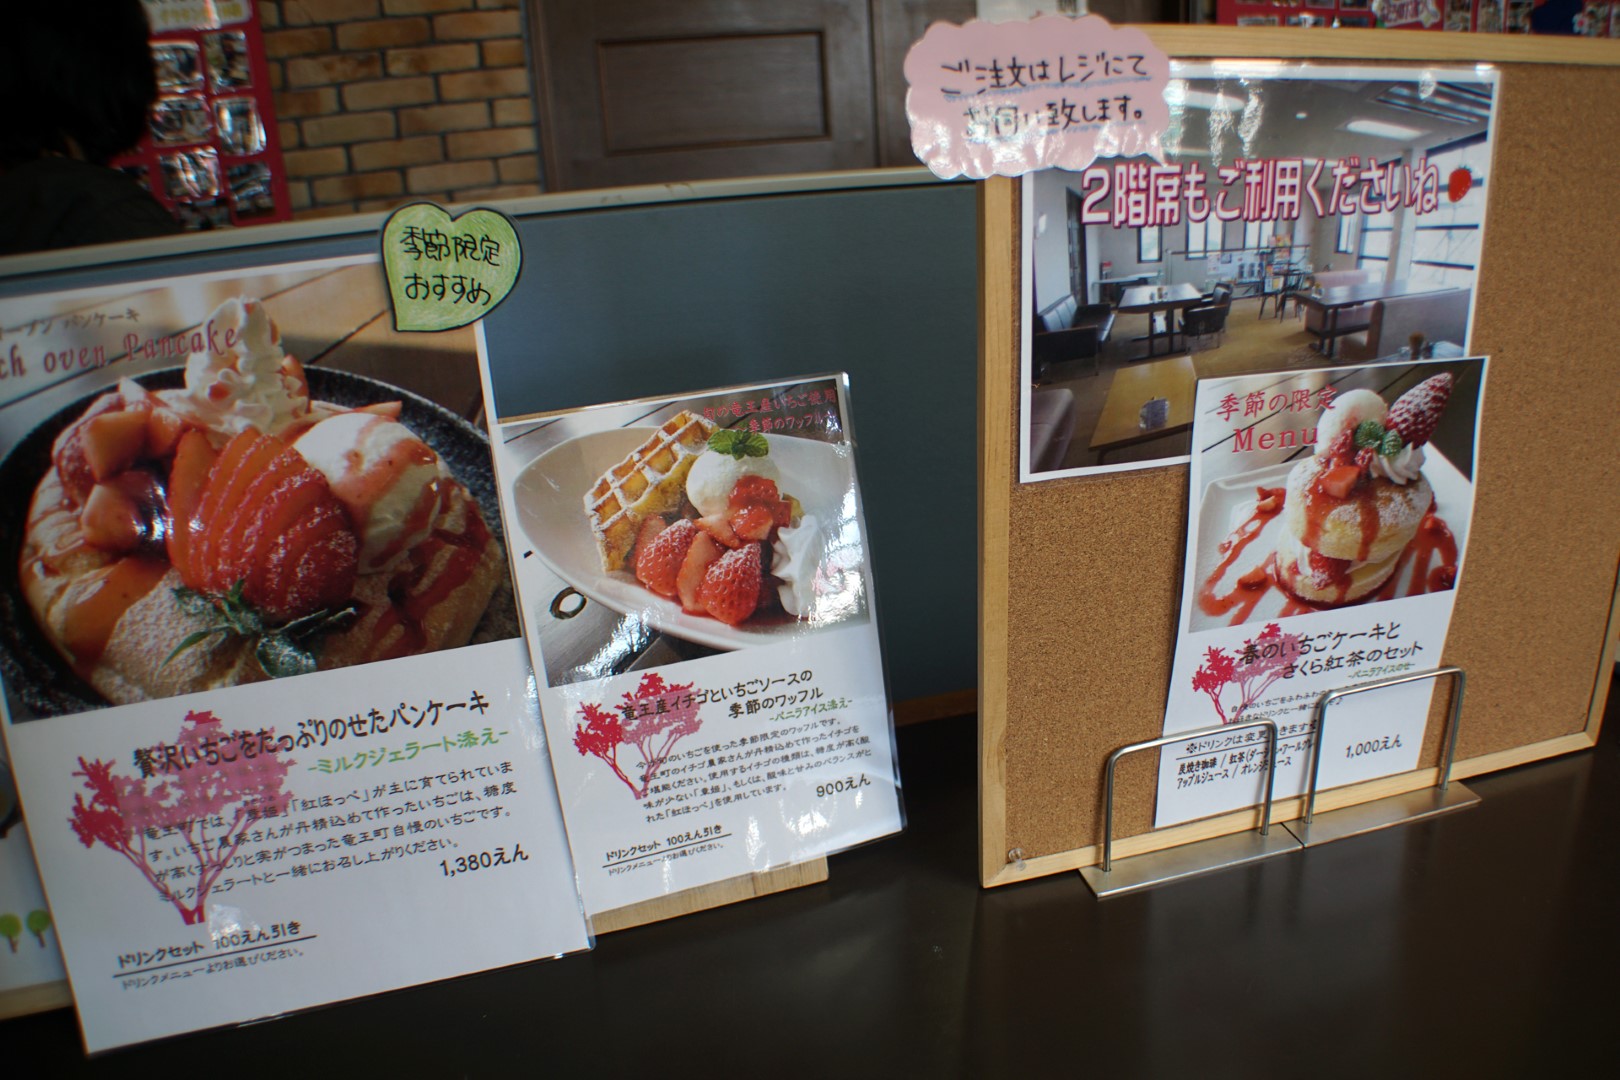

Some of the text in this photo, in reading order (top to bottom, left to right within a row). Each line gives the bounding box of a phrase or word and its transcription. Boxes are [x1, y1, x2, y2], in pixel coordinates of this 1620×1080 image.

[940, 53, 1148, 95] ご注文はレジにて
[1081, 156, 1440, 229] 2階席もご利用くださいね
[400, 226, 500, 266] 季節限定
[404, 273, 491, 306] おすすめ
[44, 345, 107, 374] oven
[123, 319, 238, 362] Pancake
[1216, 384, 1338, 422] 季節の限定
[1232, 427, 1318, 453] Menu
[1240, 622, 1401, 665] 春のいちごケーキと
[1282, 641, 1423, 679] さくら紅茶のセット
[622, 670, 812, 721] 竜王産イチゴといちごソースの
[729, 687, 823, 719] 季節のワッフル
[133, 690, 489, 778] 贅沢いちごをたっぷりのせたパンケーキ
[1346, 734, 1402, 759] 1,000えん
[816, 773, 871, 798] 900えん
[439, 844, 529, 877] 1,380えん
[606, 824, 722, 861] ドリンクセット 100えん引き
[118, 921, 300, 969] ドリンクセット 100えん引き
